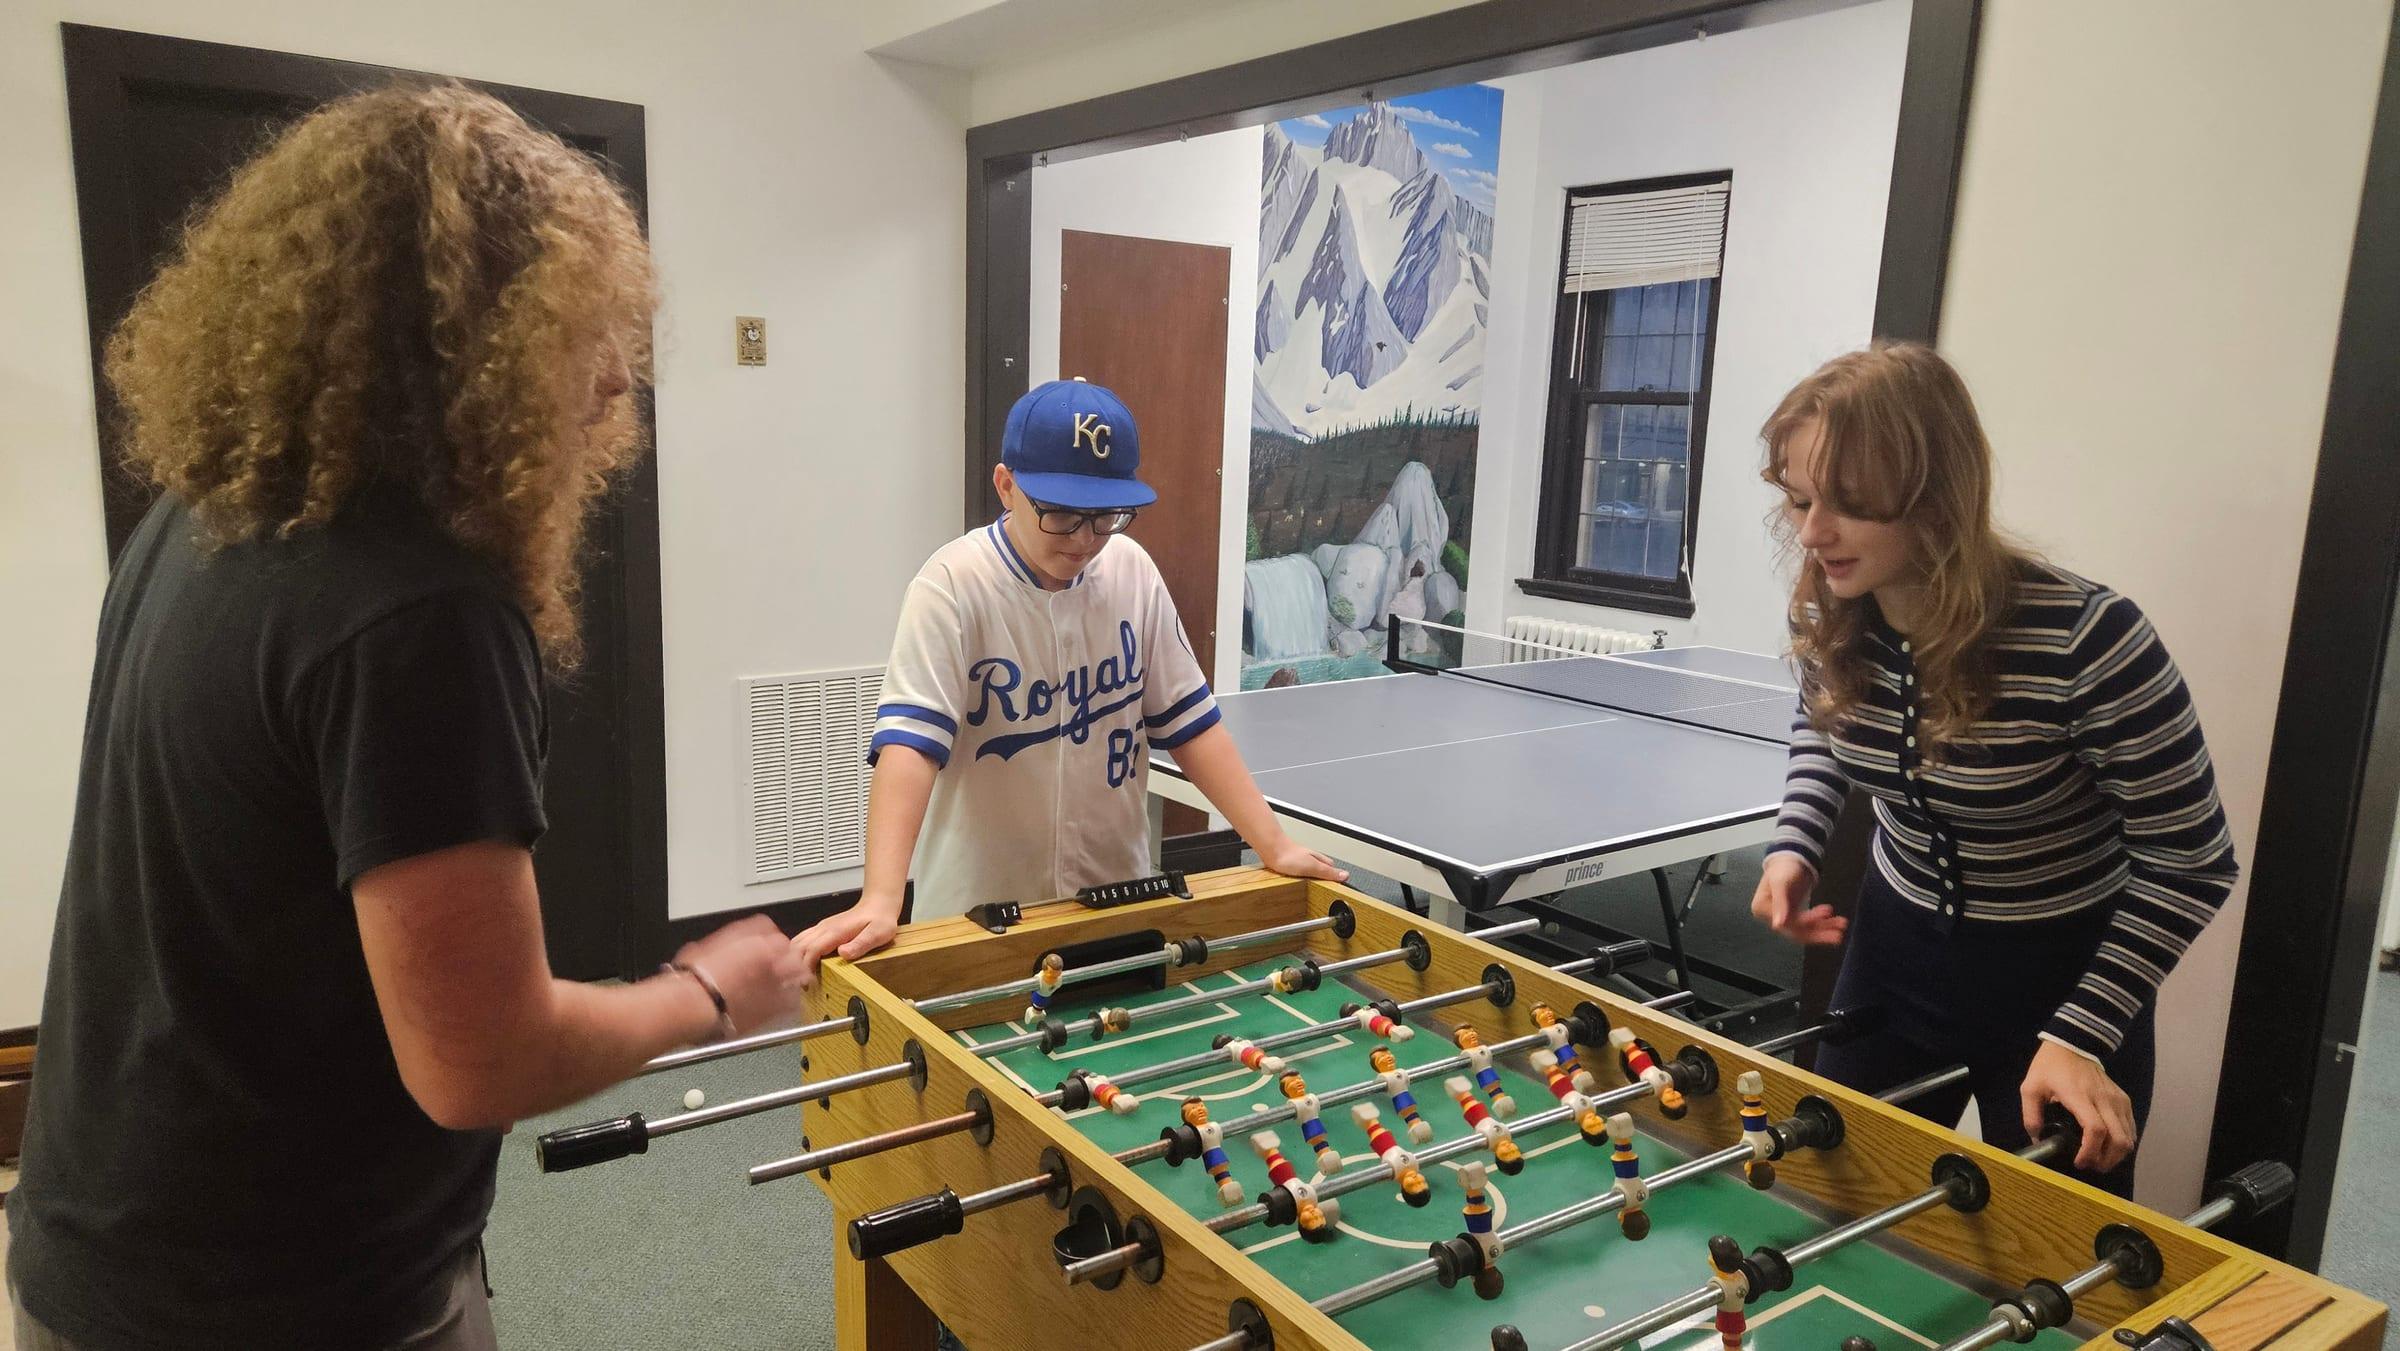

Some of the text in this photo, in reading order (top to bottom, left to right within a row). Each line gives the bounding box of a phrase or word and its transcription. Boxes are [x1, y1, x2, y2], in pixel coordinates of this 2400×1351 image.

[1073, 412, 1111, 459] KC
[1564, 861, 1604, 887] prince
[1001, 908, 1007, 918] 1
[1012, 905, 1018, 917] 2
[1091, 892, 1098, 901] 3
[1101, 890, 1107, 899] 4
[1111, 888, 1117, 898] 5
[1123, 886, 1130, 896] 6
[1143, 882, 1150, 892] 8
[1153, 881, 1159, 891] 9
[1160, 879, 1169, 889] 10
